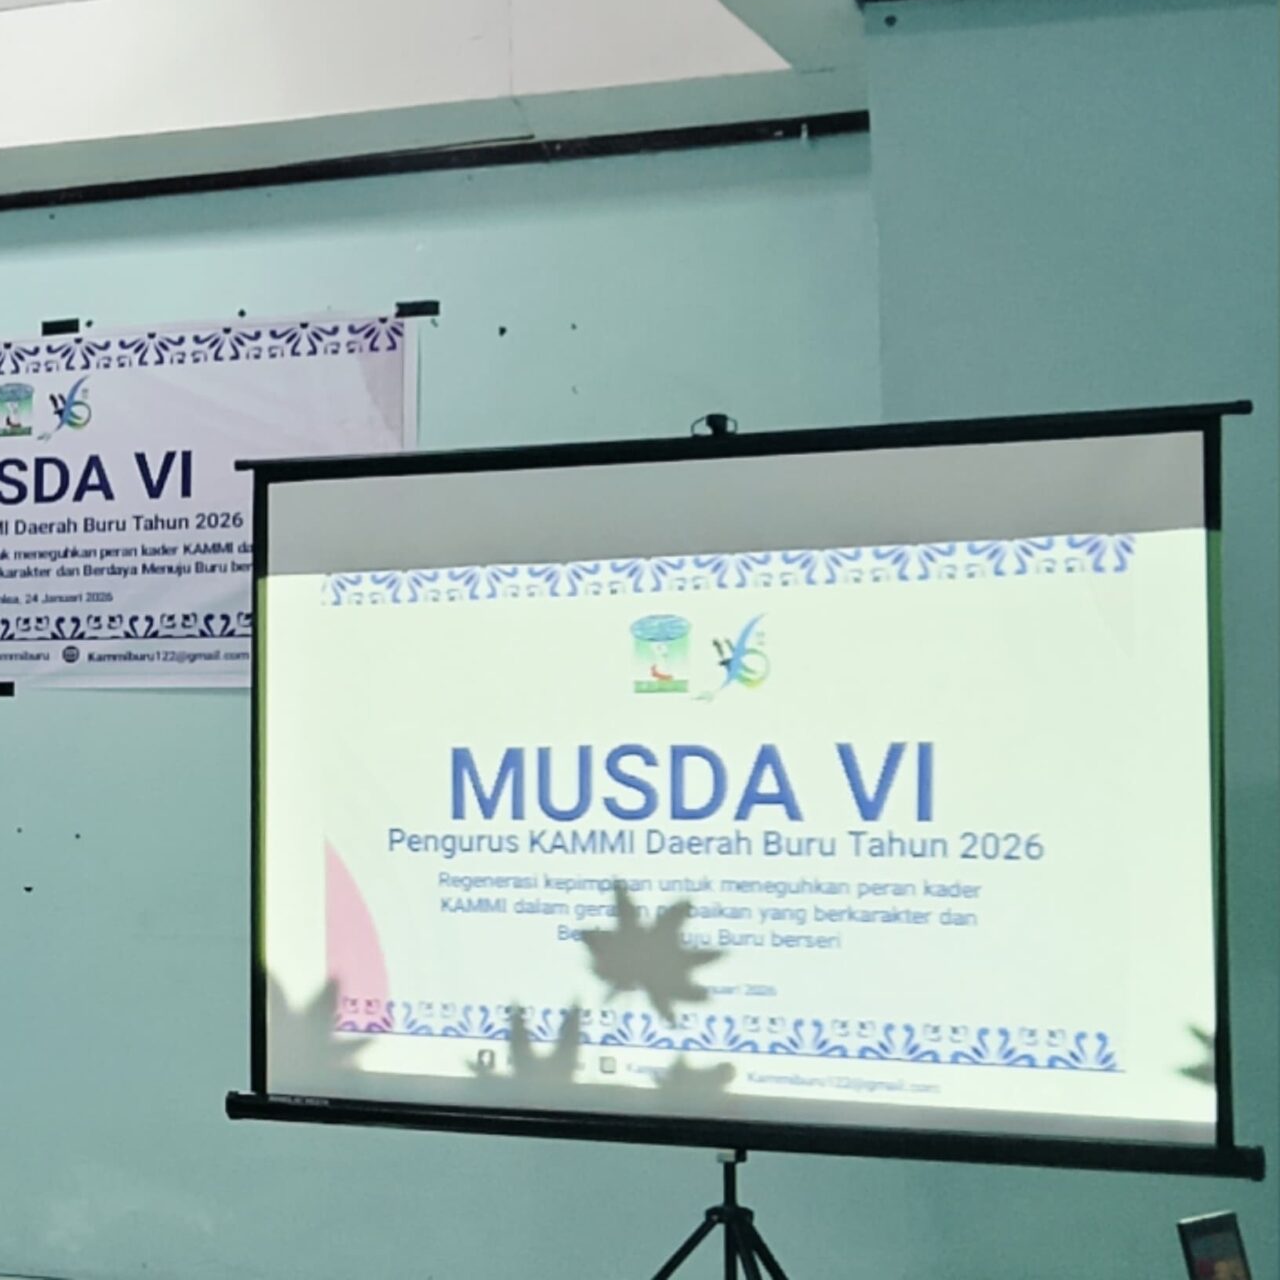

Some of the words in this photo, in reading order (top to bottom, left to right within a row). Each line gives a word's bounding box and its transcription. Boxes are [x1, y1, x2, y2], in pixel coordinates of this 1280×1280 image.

[133, 449, 193, 500] VI
[14, 518, 78, 536] Daerah
[83, 516, 127, 534] Buru
[132, 514, 190, 532] Tahun
[195, 512, 244, 530] 2026
[14, 545, 97, 561] meneguhkan
[99, 547, 138, 561] peran
[141, 543, 179, 558] kader
[183, 541, 234, 556] KAMMI
[56, 564, 81, 578] dan
[83, 563, 138, 579] Berdaya
[141, 562, 192, 578] Menuju
[194, 560, 229, 574] Buru
[25, 593, 39, 605] 24
[41, 592, 84, 605] Januari
[85, 591, 114, 604] 2026
[451, 742, 805, 823] MUSDA
[835, 740, 934, 823] VI
[388, 827, 520, 860] Pengurus
[529, 829, 635, 855] KAMMI
[646, 828, 753, 856] Daerah
[763, 830, 836, 858] Buru
[848, 830, 949, 859] Tahun
[959, 832, 1045, 861] 2026
[438, 871, 538, 891] Regenerasi
[658, 875, 712, 893] untuk
[720, 876, 850, 898] meneguhkan
[857, 880, 916, 899] peran
[923, 879, 981, 899] kader
[441, 897, 508, 914] KAMMI
[514, 897, 569, 916] dalam
[759, 905, 808, 925] yang
[814, 904, 932, 926] berkarakter
[939, 907, 978, 927] dan
[718, 928, 765, 947] Buru
[771, 930, 842, 950] berseri
